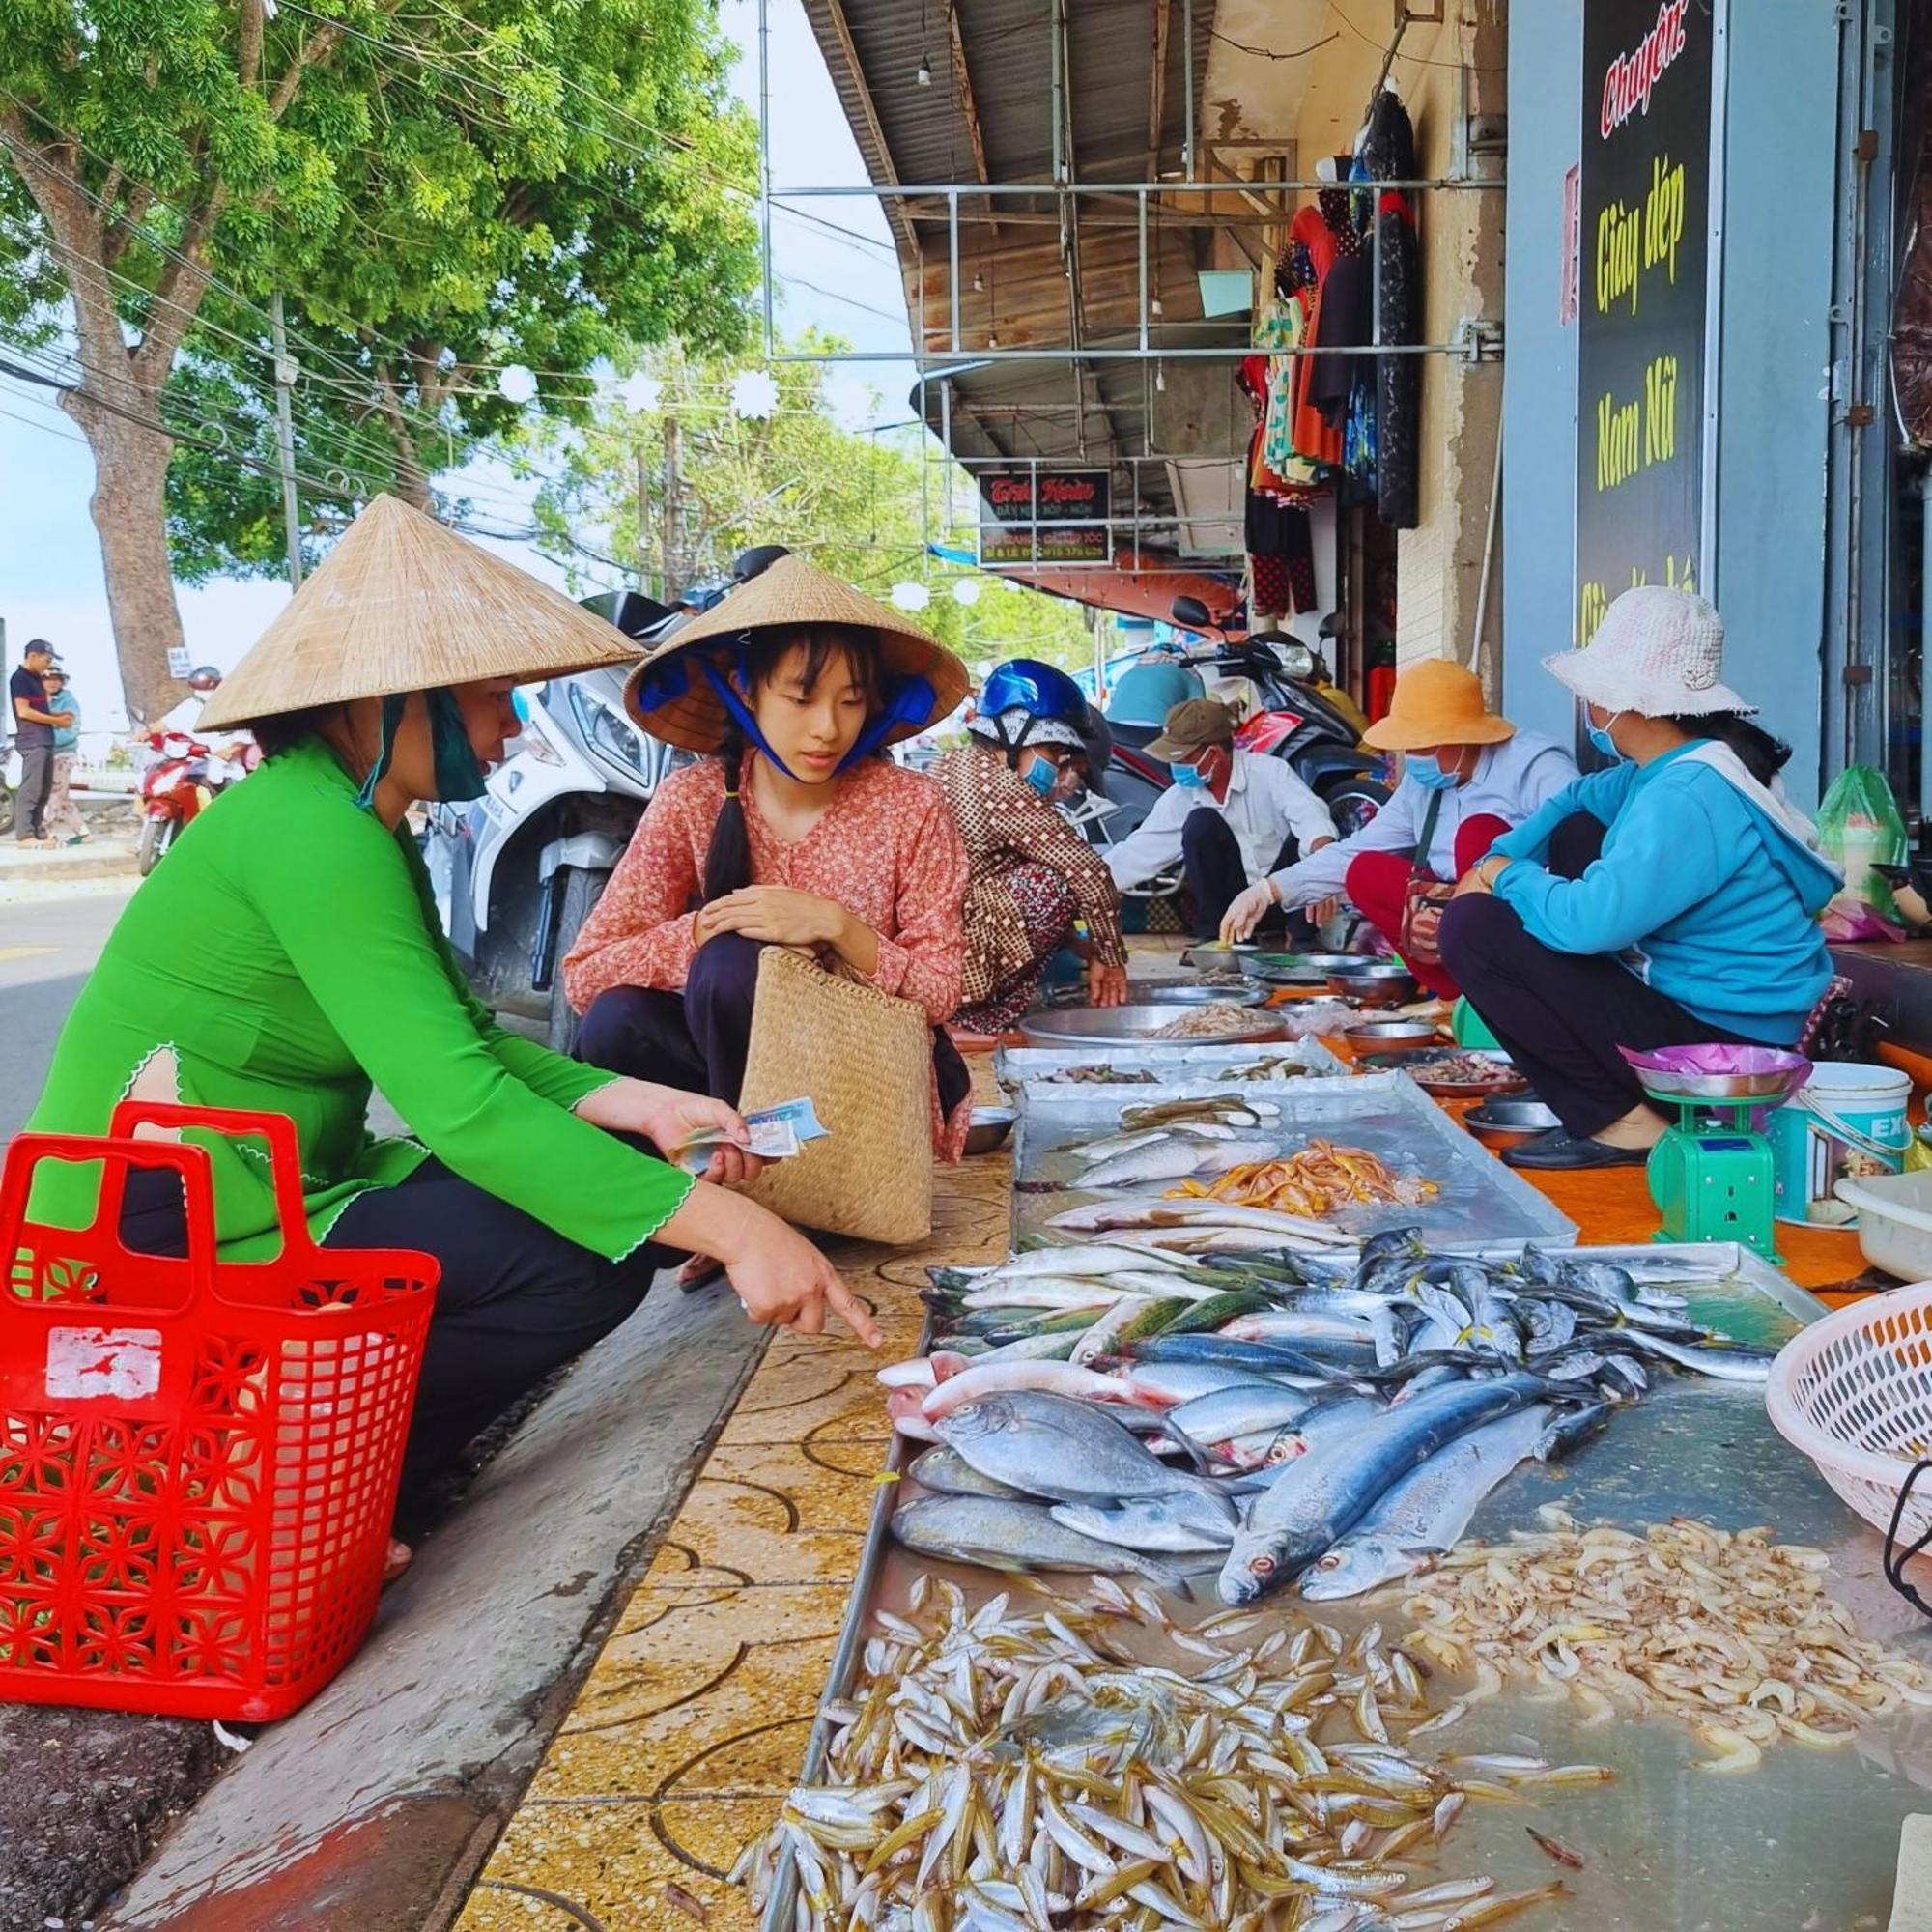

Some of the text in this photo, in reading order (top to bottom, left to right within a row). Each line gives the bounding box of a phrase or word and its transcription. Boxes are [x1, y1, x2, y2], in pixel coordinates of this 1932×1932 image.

[1597, 198, 1639, 317] Giày
[1645, 153, 1685, 286] dép
[1598, 355, 1677, 493] Nam Nữ
